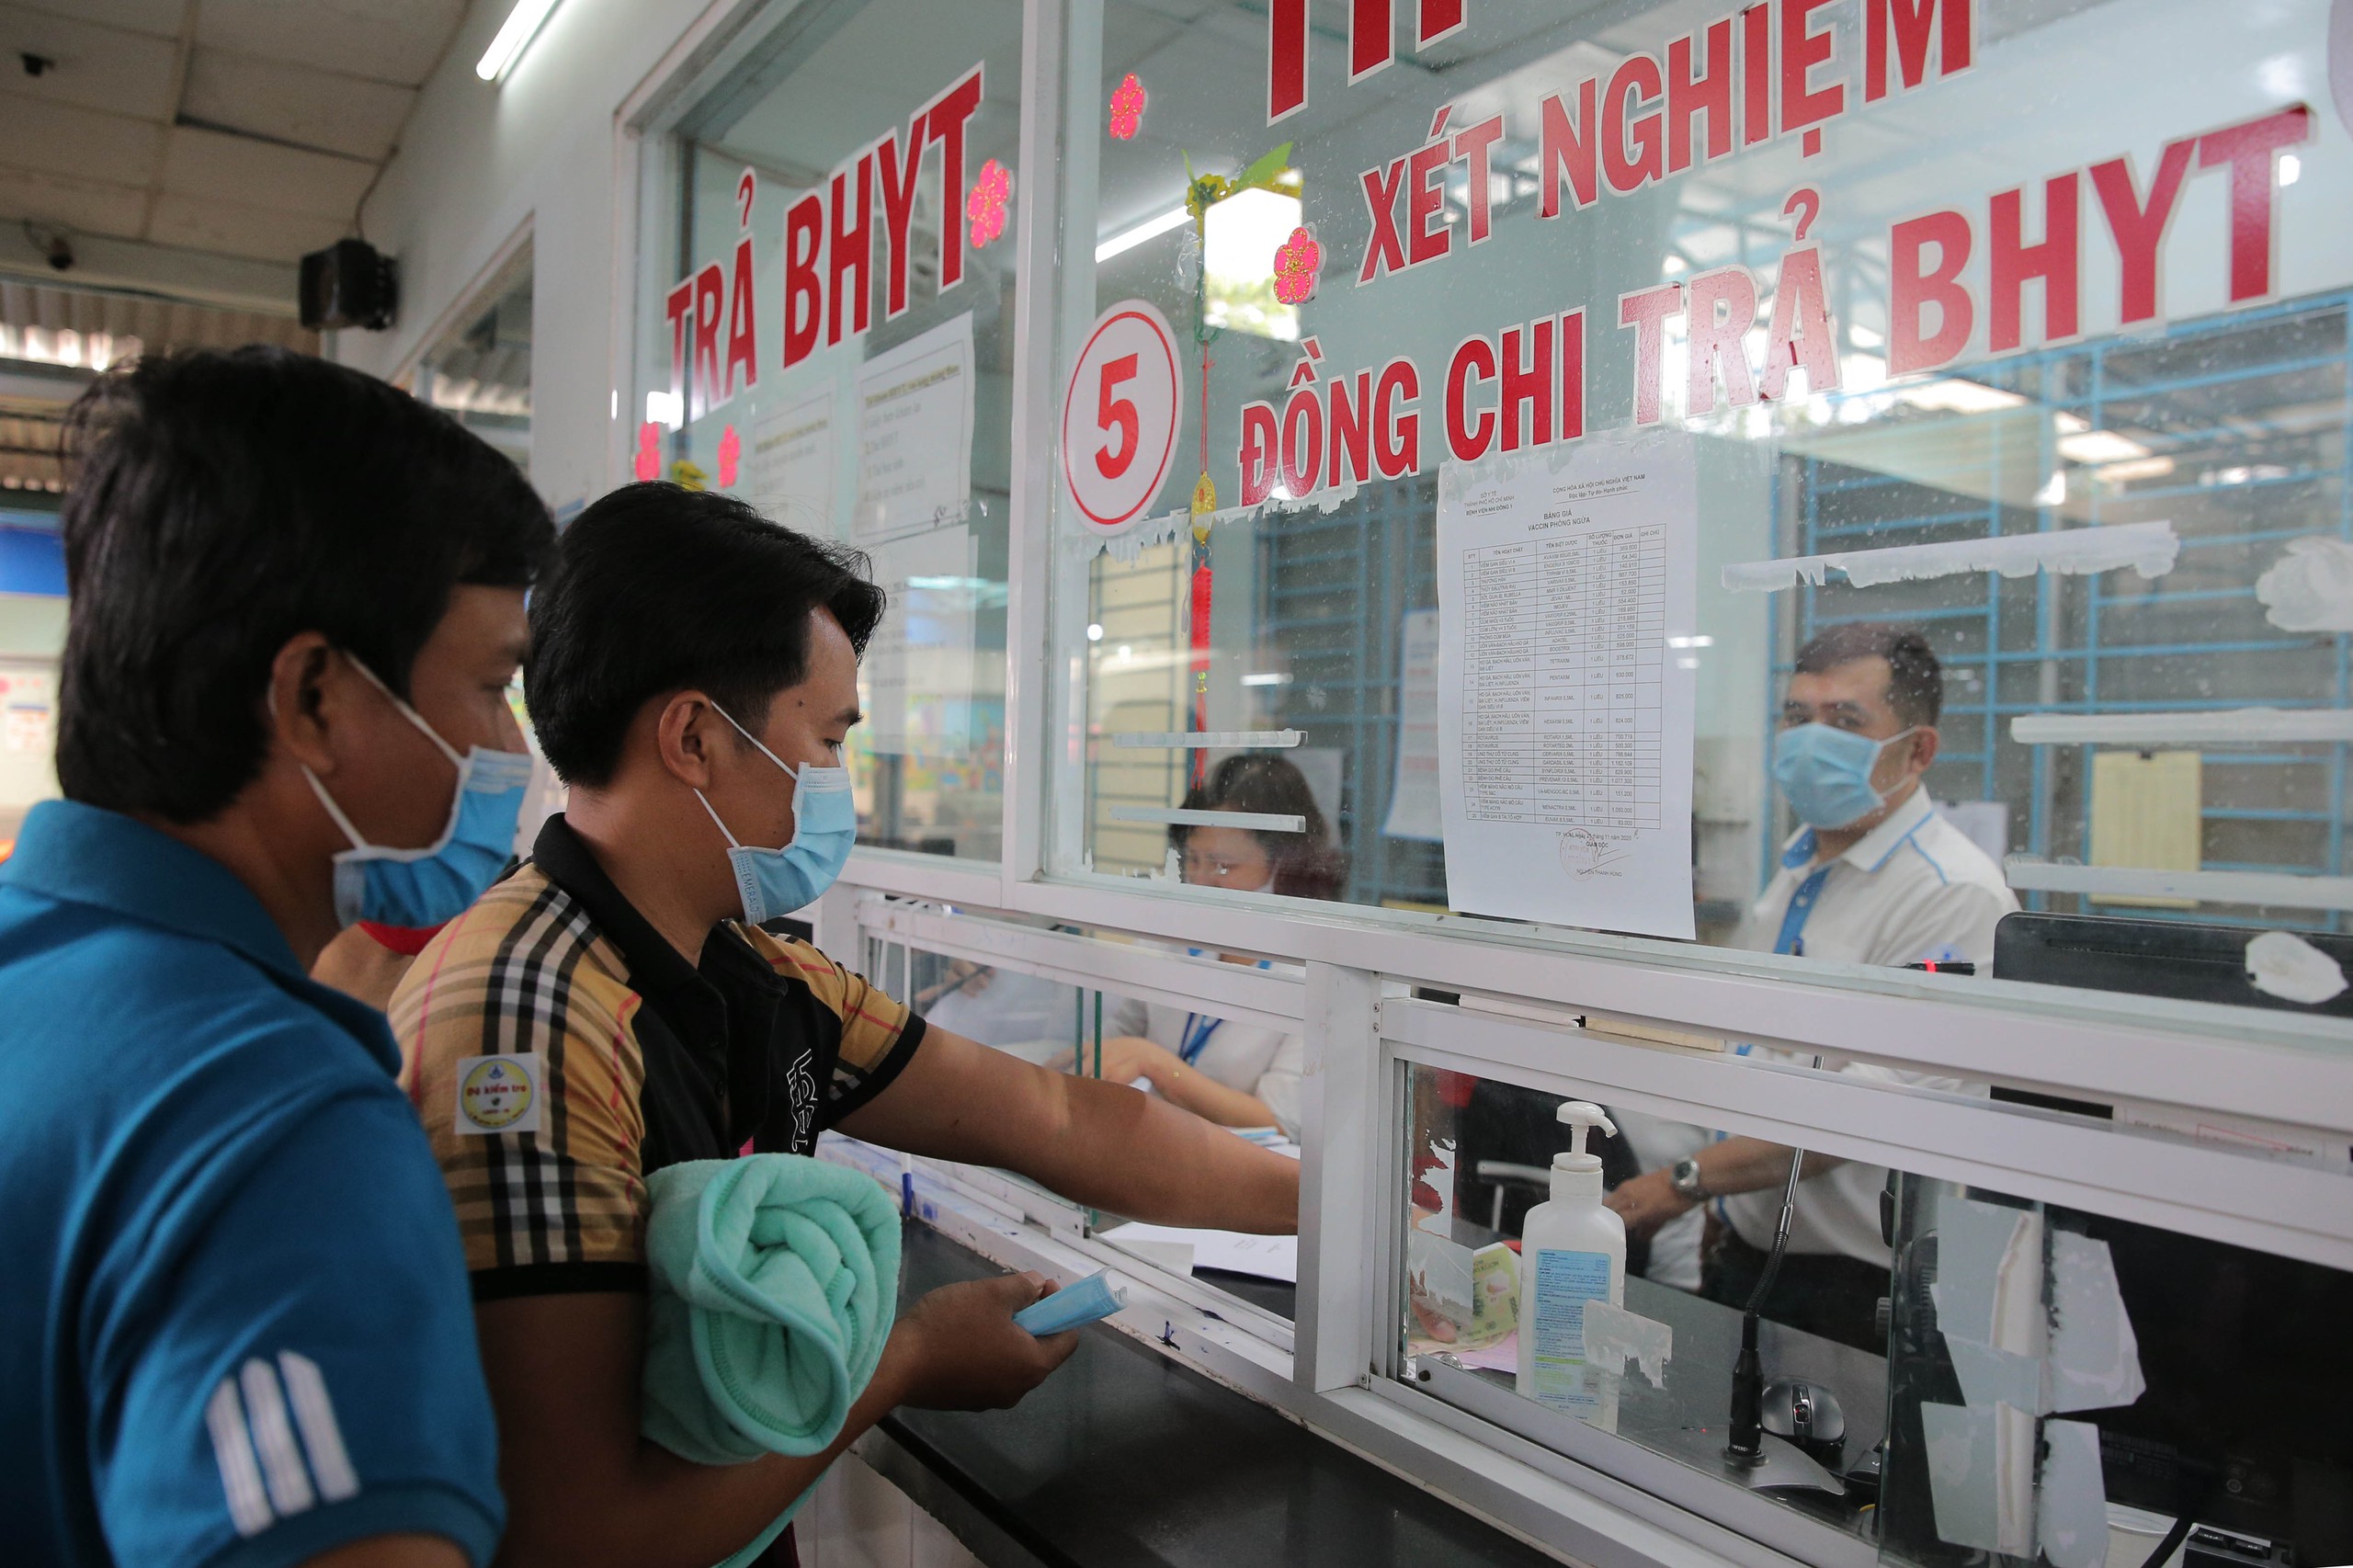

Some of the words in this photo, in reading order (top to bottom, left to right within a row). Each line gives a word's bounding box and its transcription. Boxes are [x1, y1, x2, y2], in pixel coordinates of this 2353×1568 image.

[665, 168, 757, 429] TRẢ
[783, 66, 983, 369] BHYT
[1358, 103, 1504, 284] XÉT
[1238, 337, 1419, 508] ĐỒNG
[1445, 311, 1584, 460] CHI
[1620, 187, 1840, 426] TRẢ
[1890, 104, 2311, 376] BHYT
[1095, 352, 1139, 479] 5
[1528, 522, 1549, 531] VACCIN
[1550, 518, 1571, 528] PHÒNG
[1573, 517, 1590, 525] NGỪA
[1543, 510, 1561, 520] BẢNG
[1562, 508, 1572, 517] GIÁ
